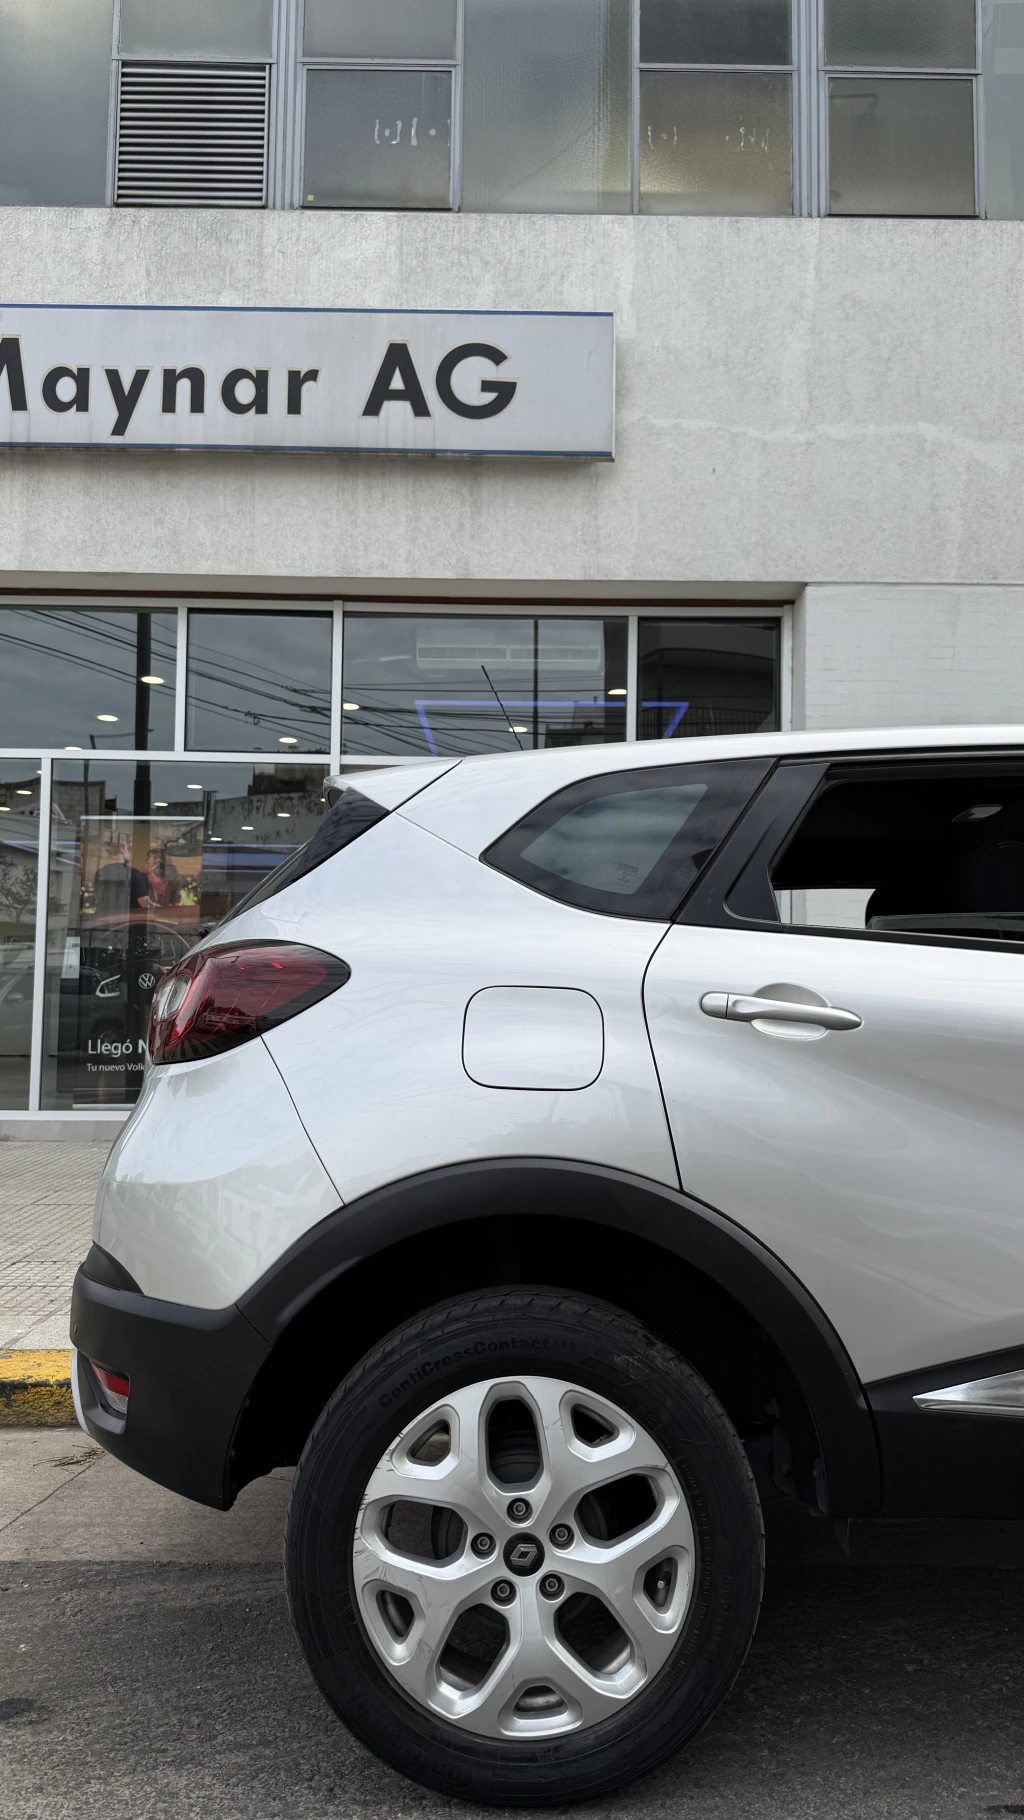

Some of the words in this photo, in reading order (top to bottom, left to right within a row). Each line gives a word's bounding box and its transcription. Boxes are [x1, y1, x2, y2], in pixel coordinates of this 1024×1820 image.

[359, 340, 519, 420] AG
[86, 1063, 98, 1072] Tu
[99, 1064, 126, 1072] nuevo
[88, 1038, 133, 1058] Llegó
[378, 1336, 550, 1408] ContiCrossContact
